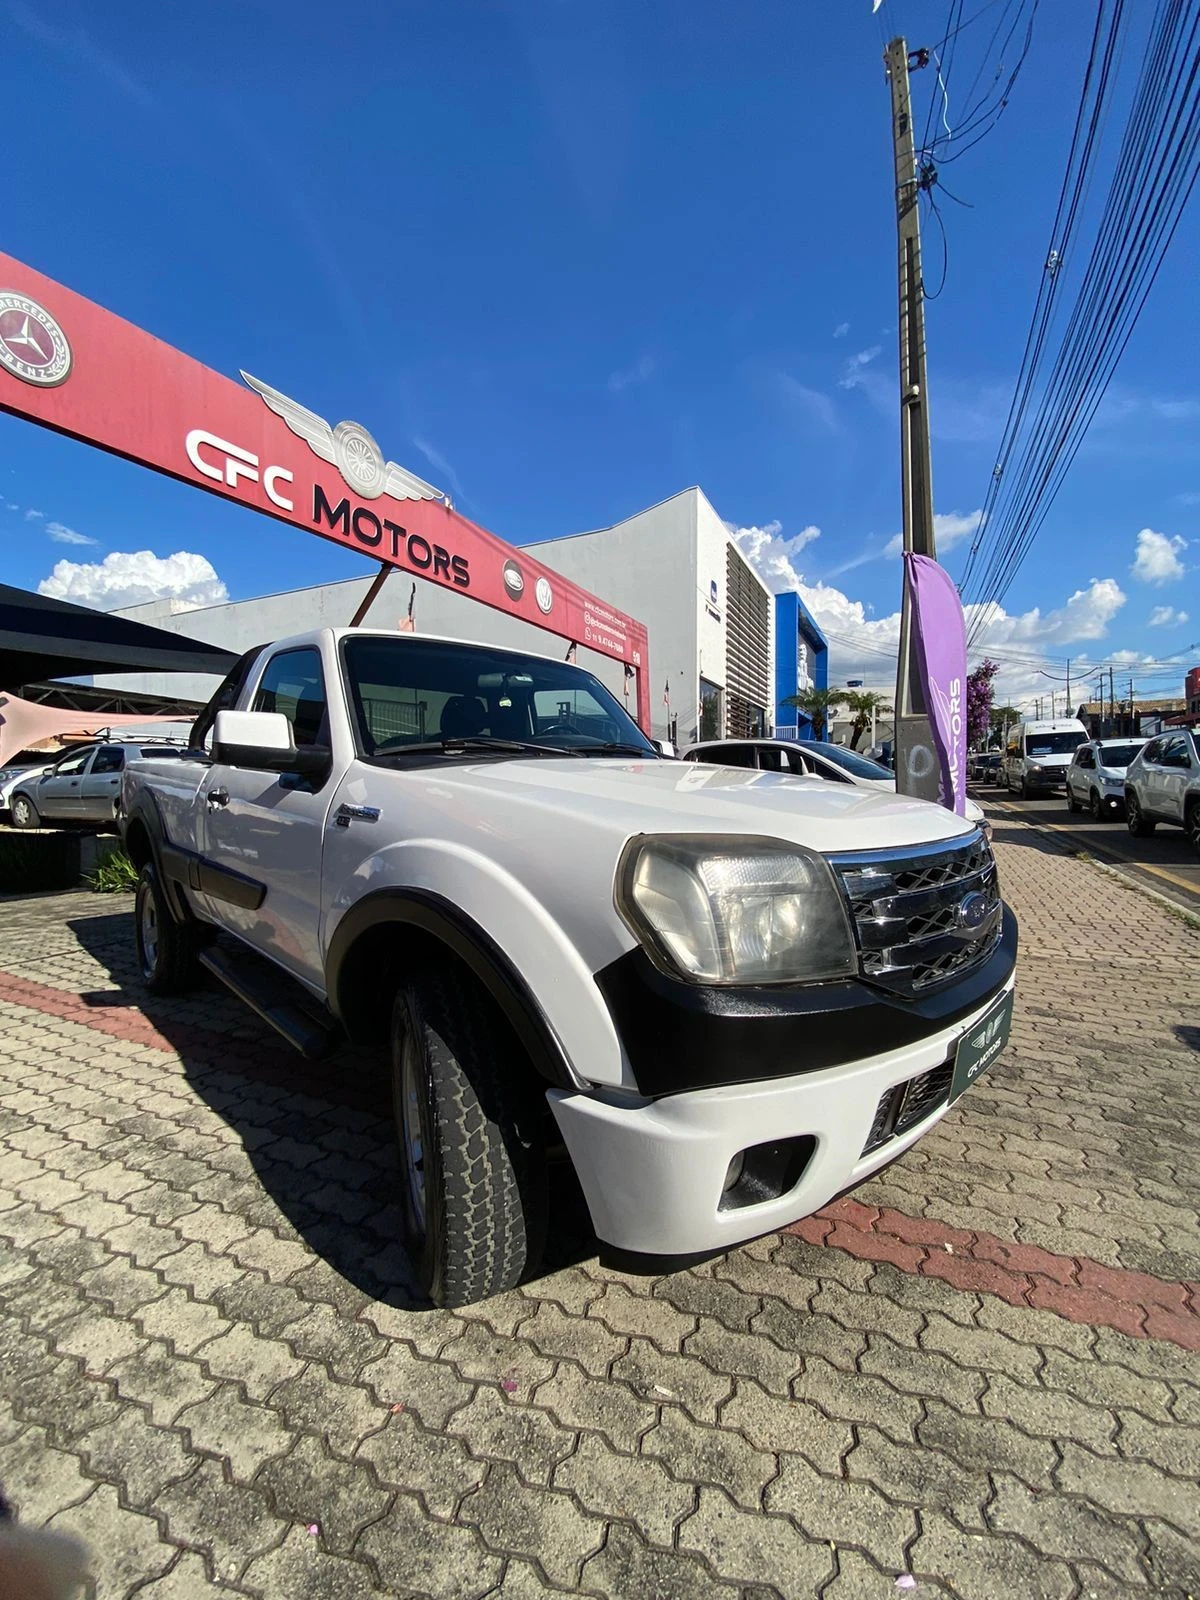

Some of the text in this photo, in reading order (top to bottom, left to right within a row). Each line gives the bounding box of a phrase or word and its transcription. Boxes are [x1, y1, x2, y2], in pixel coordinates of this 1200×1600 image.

[0, 298, 60, 338] MERCEDES
[5, 353, 47, 378] BENZ
[185, 429, 471, 588] CFC MOTORS
